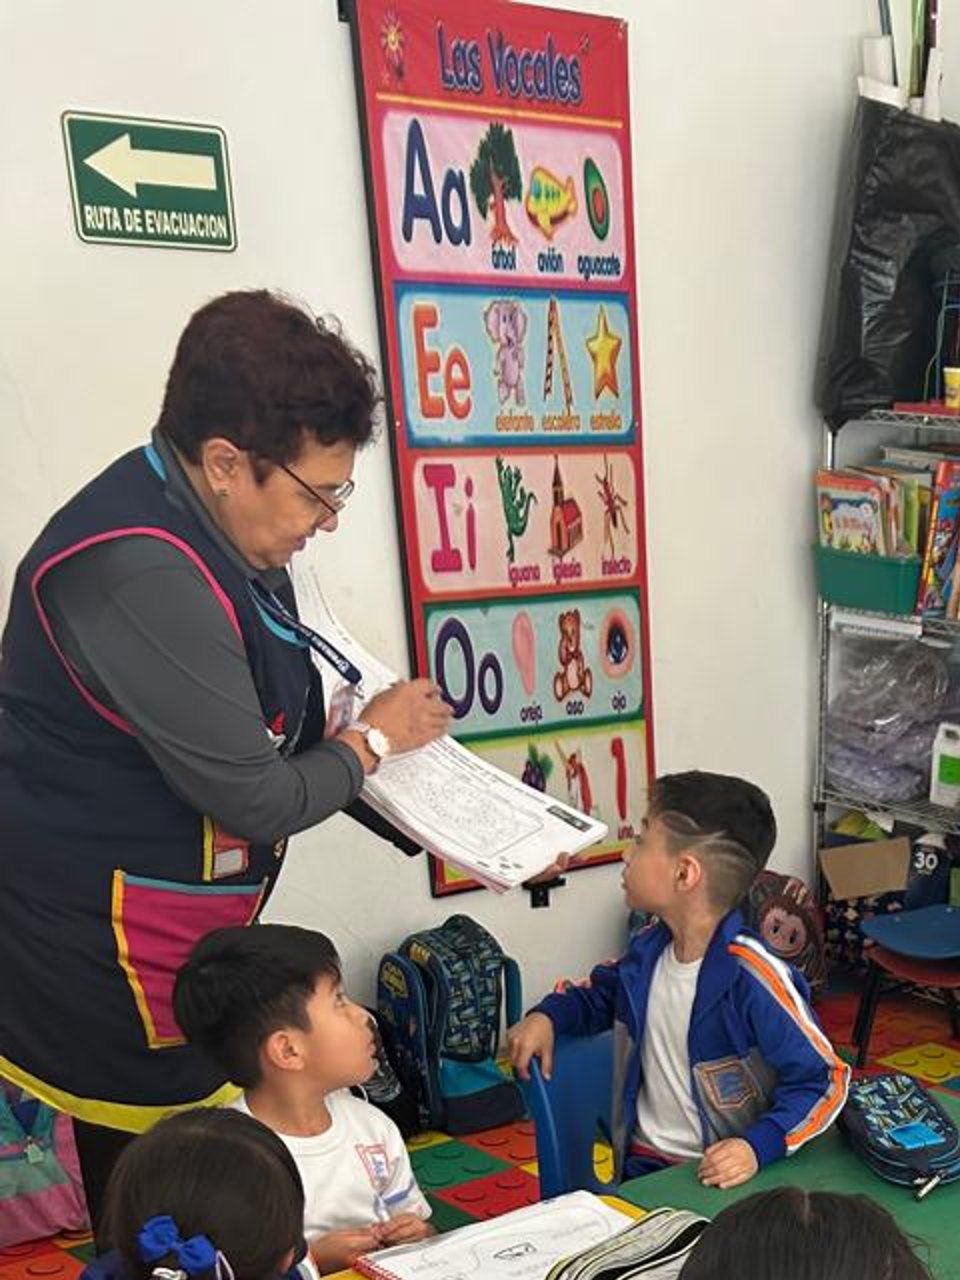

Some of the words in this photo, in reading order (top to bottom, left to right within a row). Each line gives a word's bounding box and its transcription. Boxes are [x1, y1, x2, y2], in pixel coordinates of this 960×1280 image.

[437, 22, 481, 93] Las
[487, 30, 582, 103] Vocales
[402, 118, 471, 246] Aa
[84, 205, 122, 230] RUTA
[124, 208, 143, 232] DE
[144, 209, 228, 239] EVACUACION
[491, 244, 517, 270] árbol
[537, 247, 564, 273] avión
[577, 253, 621, 280] aguacate
[413, 304, 472, 419] Ee
[423, 463, 477, 572] Ii
[509, 562, 541, 587] iguana
[552, 556, 582, 584] iglesia
[602, 555, 631, 576] insecto
[435, 617, 503, 720] Oo
[520, 701, 543, 727] oreja
[565, 699, 585, 716] oso
[612, 692, 627, 714] ojo
[914, 851, 938, 870] 30
